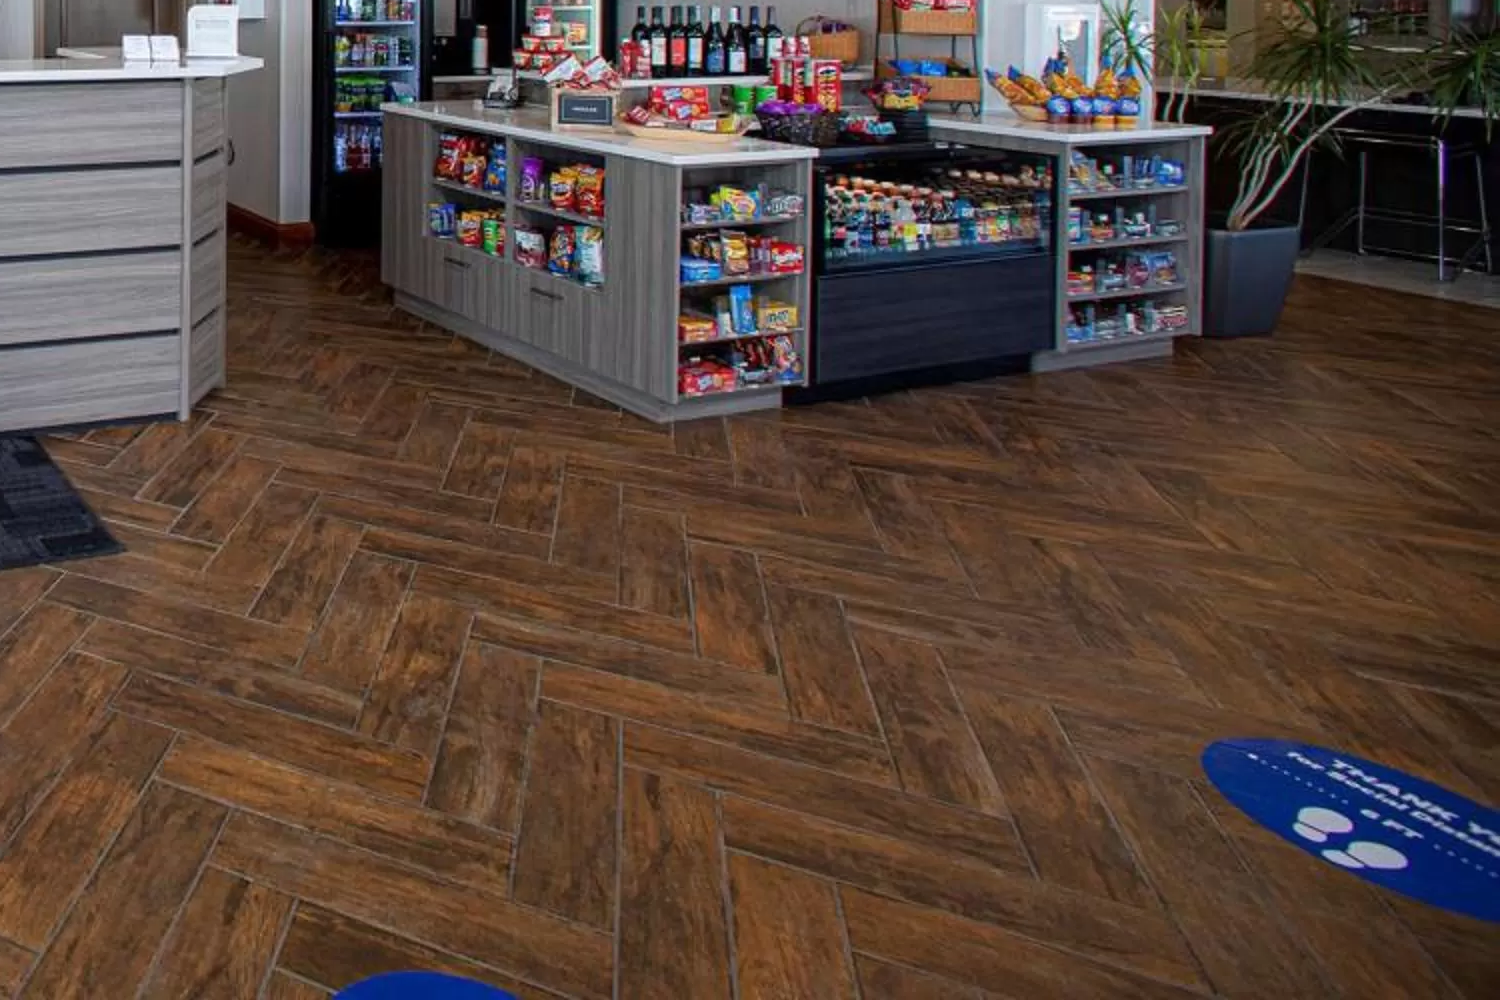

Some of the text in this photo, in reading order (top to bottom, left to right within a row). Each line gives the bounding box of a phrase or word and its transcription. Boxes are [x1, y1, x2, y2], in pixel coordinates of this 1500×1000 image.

[1285, 752, 1326, 771] for
[1326, 770, 1410, 811] Social
[1332, 758, 1460, 822] THANK
[1381, 819, 1425, 839] FT
